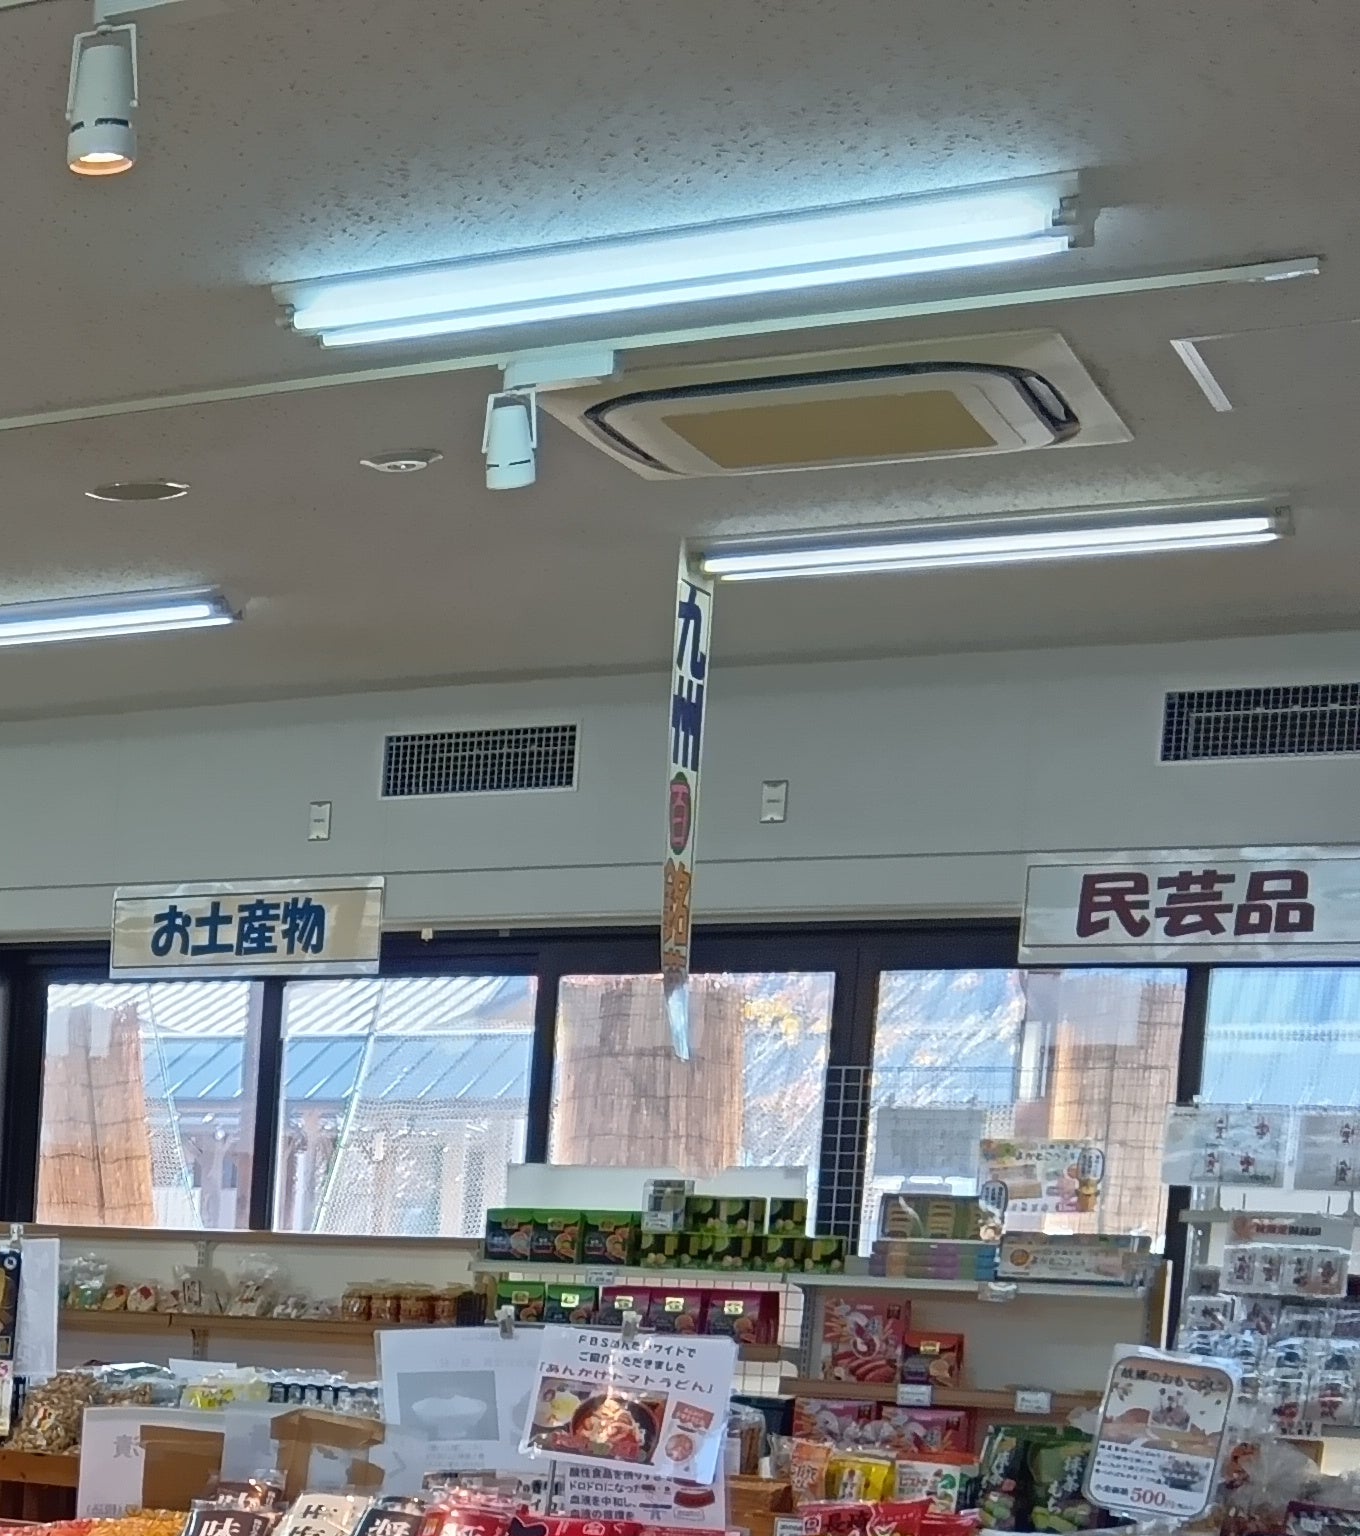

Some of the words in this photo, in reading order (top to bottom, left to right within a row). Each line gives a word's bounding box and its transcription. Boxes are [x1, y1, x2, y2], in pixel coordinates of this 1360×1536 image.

[150, 896, 326, 957] お土産物
[1076, 869, 1315, 938] 民芸品
